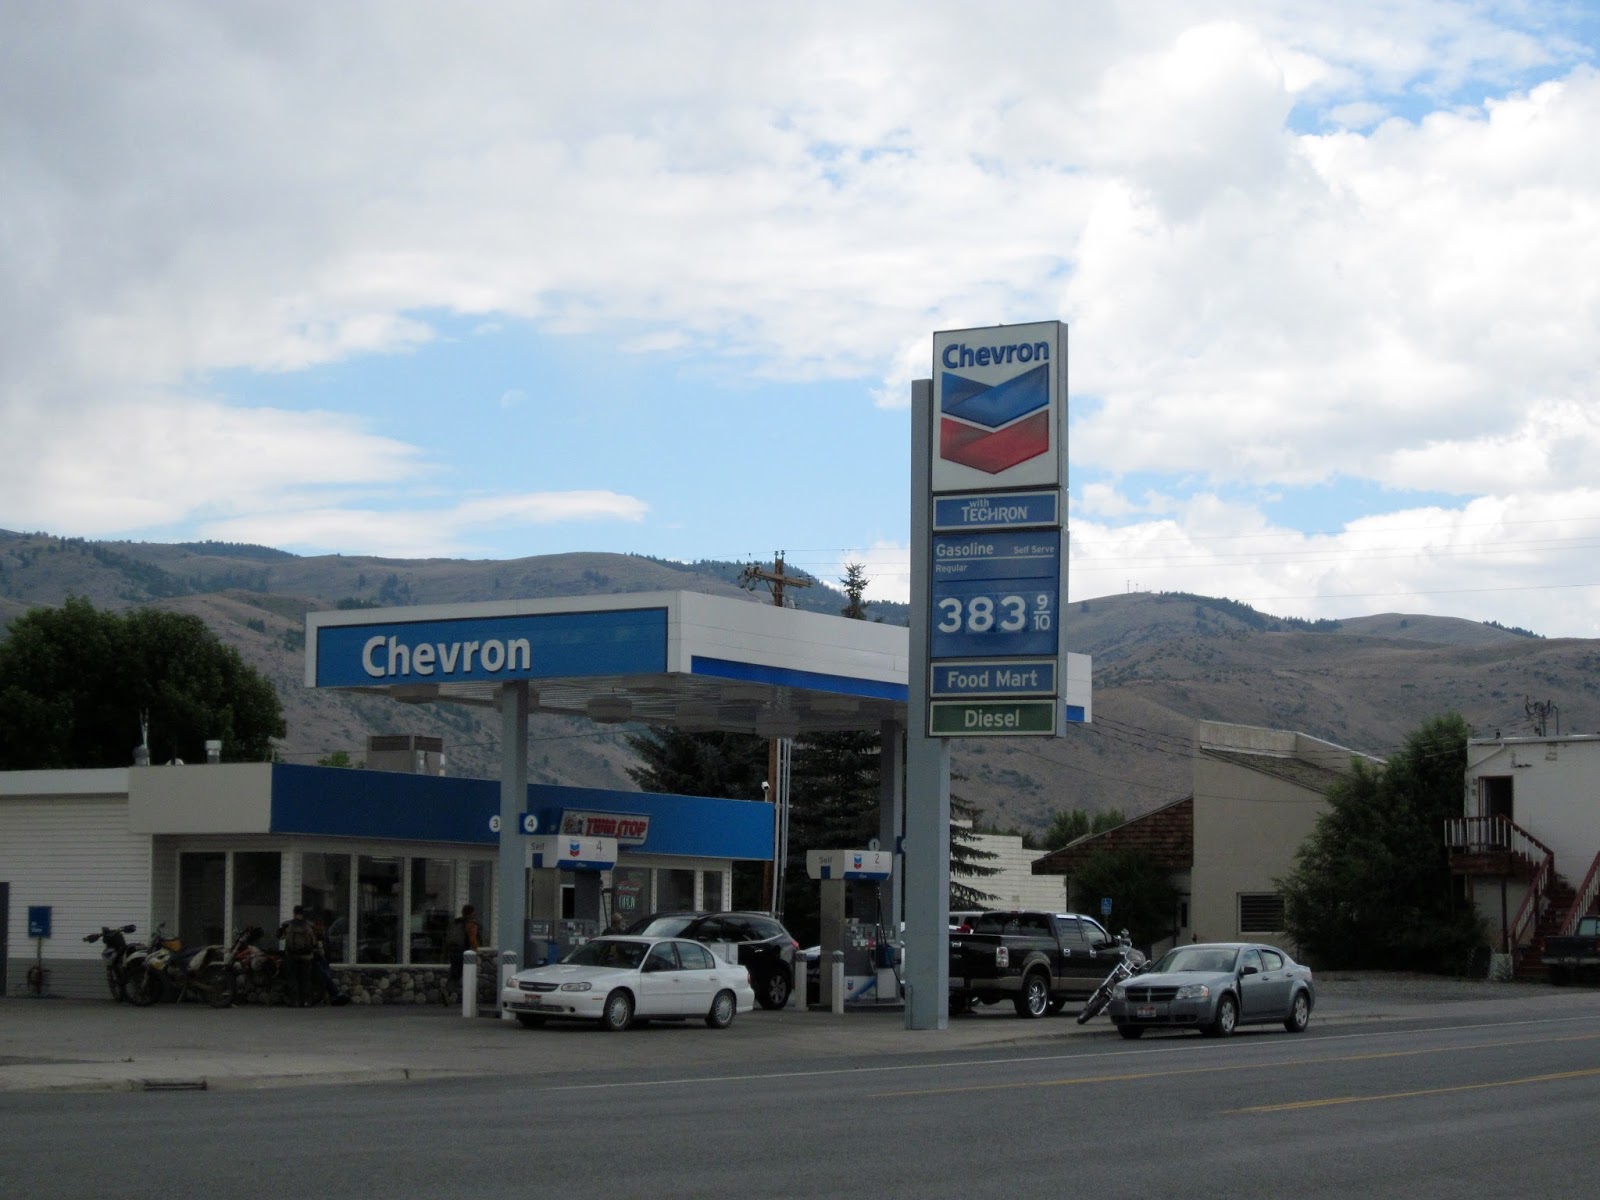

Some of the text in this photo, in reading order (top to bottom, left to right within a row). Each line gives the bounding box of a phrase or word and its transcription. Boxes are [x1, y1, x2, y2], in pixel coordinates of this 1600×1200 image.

[942, 341, 1049, 369] Chevron
[969, 498, 990, 508] with
[961, 506, 1028, 523] TECHRON
[936, 542, 994, 557] Gasoline
[1013, 545, 1055, 555] Self Serve
[935, 564, 968, 574] Regular
[1036, 594, 1048, 610] 9
[937, 595, 1026, 633] 383
[1033, 614, 1050, 630] 10
[362, 634, 532, 678] Chevron
[947, 670, 1038, 688] Food Mart
[964, 709, 1020, 728] Diesel
[492, 819, 499, 828] 3
[527, 819, 534, 828] 4
[596, 840, 602, 852] 4
[819, 856, 832, 864] Self
[874, 853, 880, 864] 2
